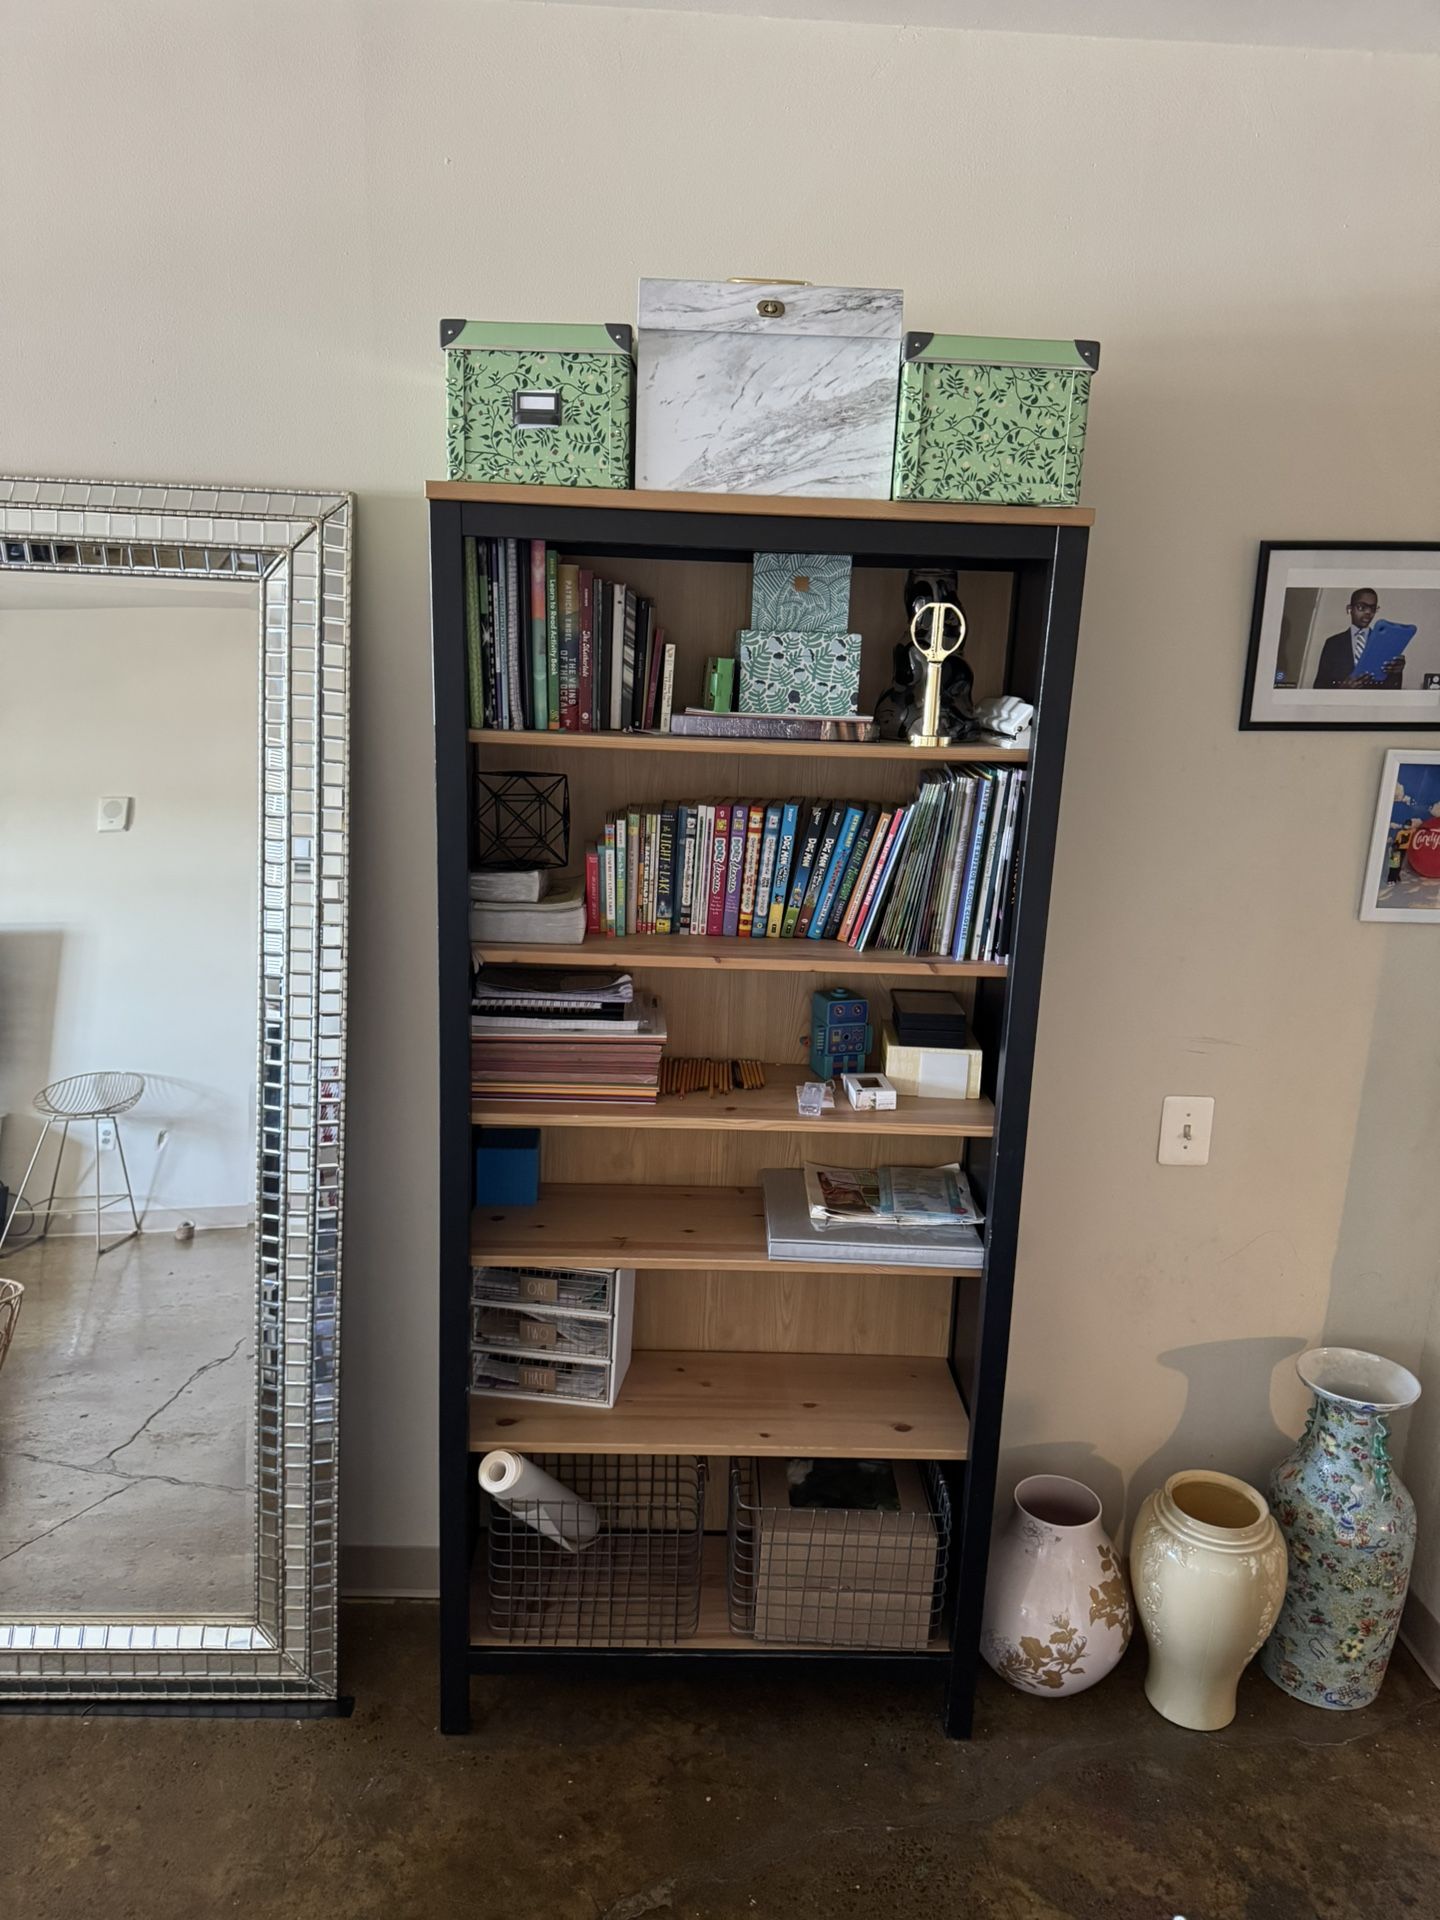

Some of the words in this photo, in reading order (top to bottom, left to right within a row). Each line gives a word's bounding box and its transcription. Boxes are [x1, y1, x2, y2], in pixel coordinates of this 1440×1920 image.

[550, 631, 558, 656] Activity
[561, 650, 568, 663] OF
[560, 666, 568, 681] THE
[569, 658, 577, 675] THE
[568, 678, 576, 704] VEINS
[845, 831, 854, 847] HART
[862, 827, 870, 837] THE
[660, 833, 672, 862] LIGHT
[714, 838, 725, 862] DORK
[731, 837, 742, 862] DORK
[782, 835, 792, 850] DOG
[806, 838, 817, 852] DOG
[823, 838, 835, 853] DOG
[780, 851, 790, 864] MAN
[852, 837, 868, 865] MUTANT
[802, 853, 813, 868] MAN
[817, 853, 829, 868] MAN
[713, 863, 724, 894] diaries
[728, 862, 741, 893] diaries
[527, 1282, 549, 1297] ONE
[526, 1325, 549, 1341] TWO
[523, 1371, 548, 1386] THREE
